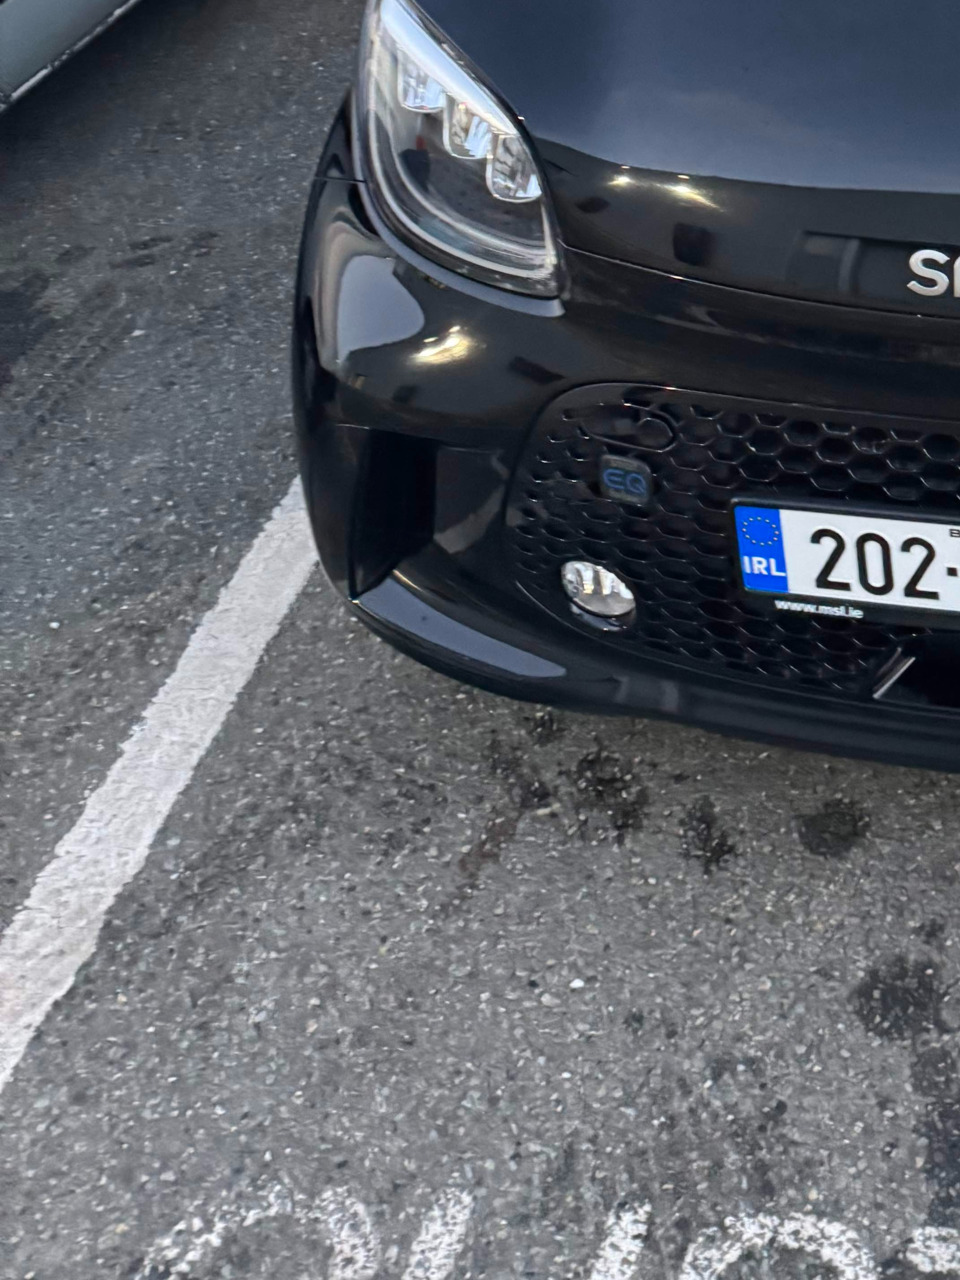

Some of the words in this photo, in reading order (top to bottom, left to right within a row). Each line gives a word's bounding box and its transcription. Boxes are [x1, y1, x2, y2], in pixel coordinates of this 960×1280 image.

[602, 468, 648, 496] EQ
[742, 555, 787, 577] IRL
[774, 599, 865, 619] www.msl.ie
